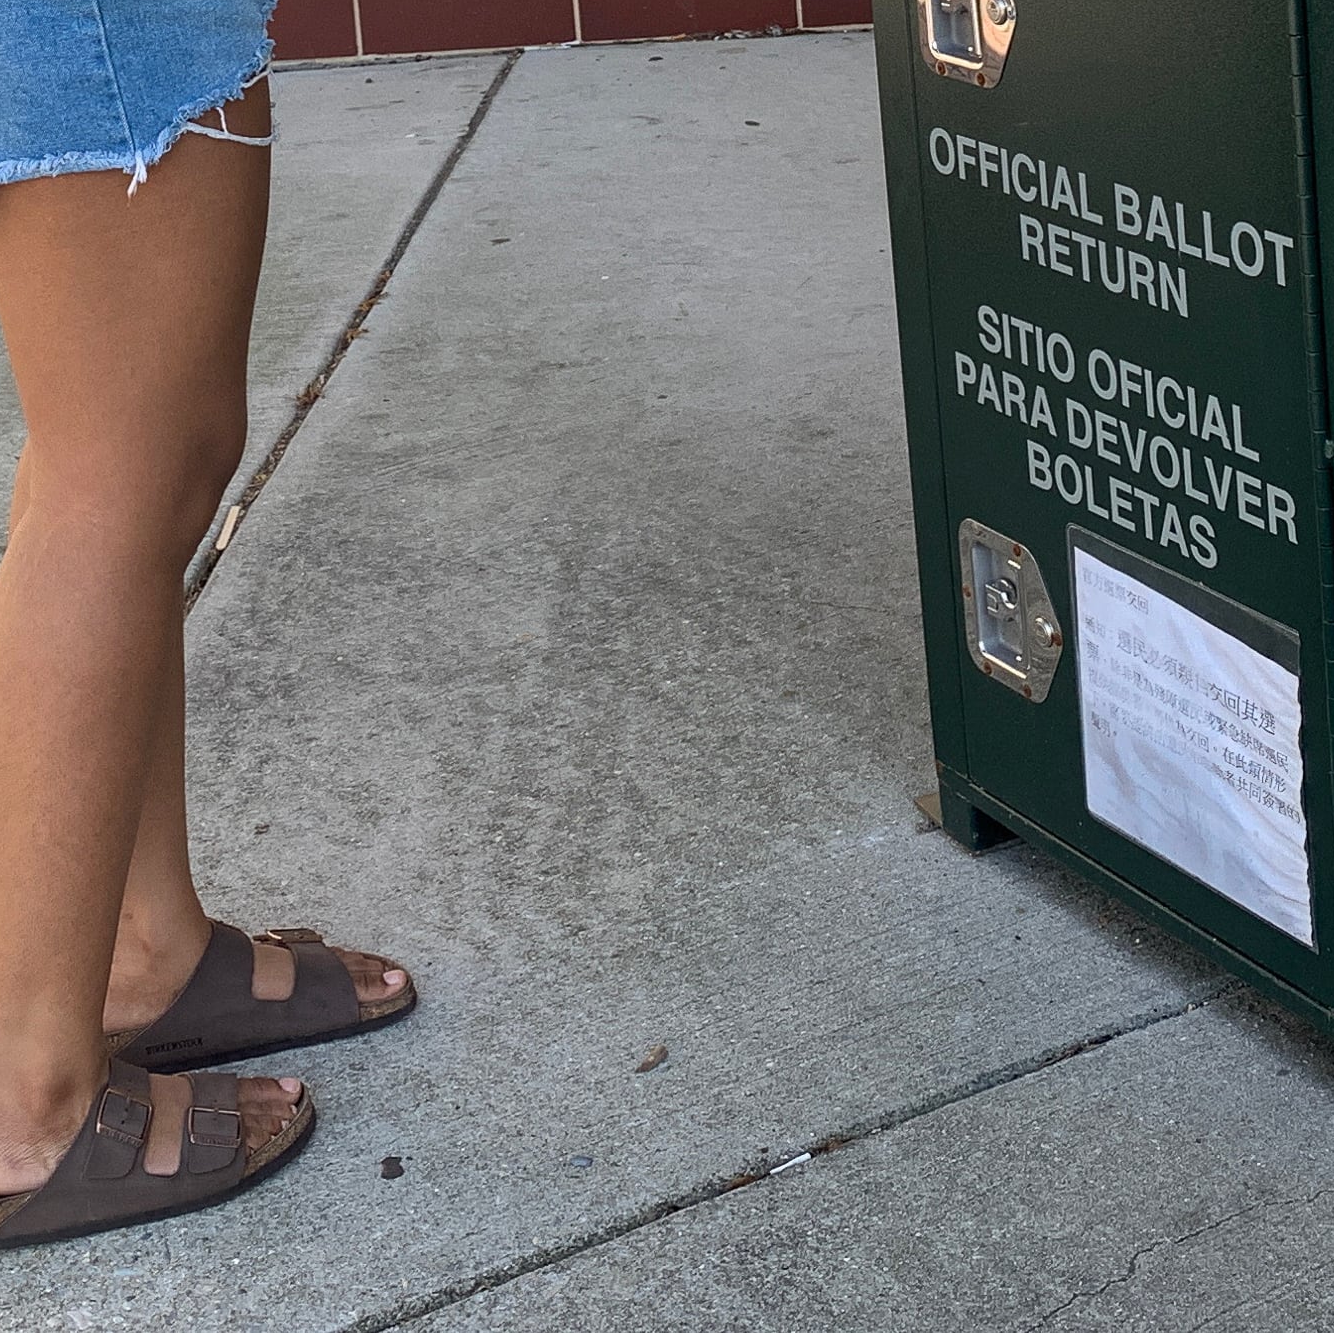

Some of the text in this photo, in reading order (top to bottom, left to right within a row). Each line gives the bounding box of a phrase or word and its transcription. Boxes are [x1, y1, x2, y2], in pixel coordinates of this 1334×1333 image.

[929, 127, 1294, 287] OFFICIAL BALLOT
[1019, 214, 1189, 318] RETURN
[954, 351, 1298, 545] PARA DEVOLVER
[977, 305, 1260, 462] SITIO OFICIAL
[1027, 439, 1218, 569] BOLETAS
